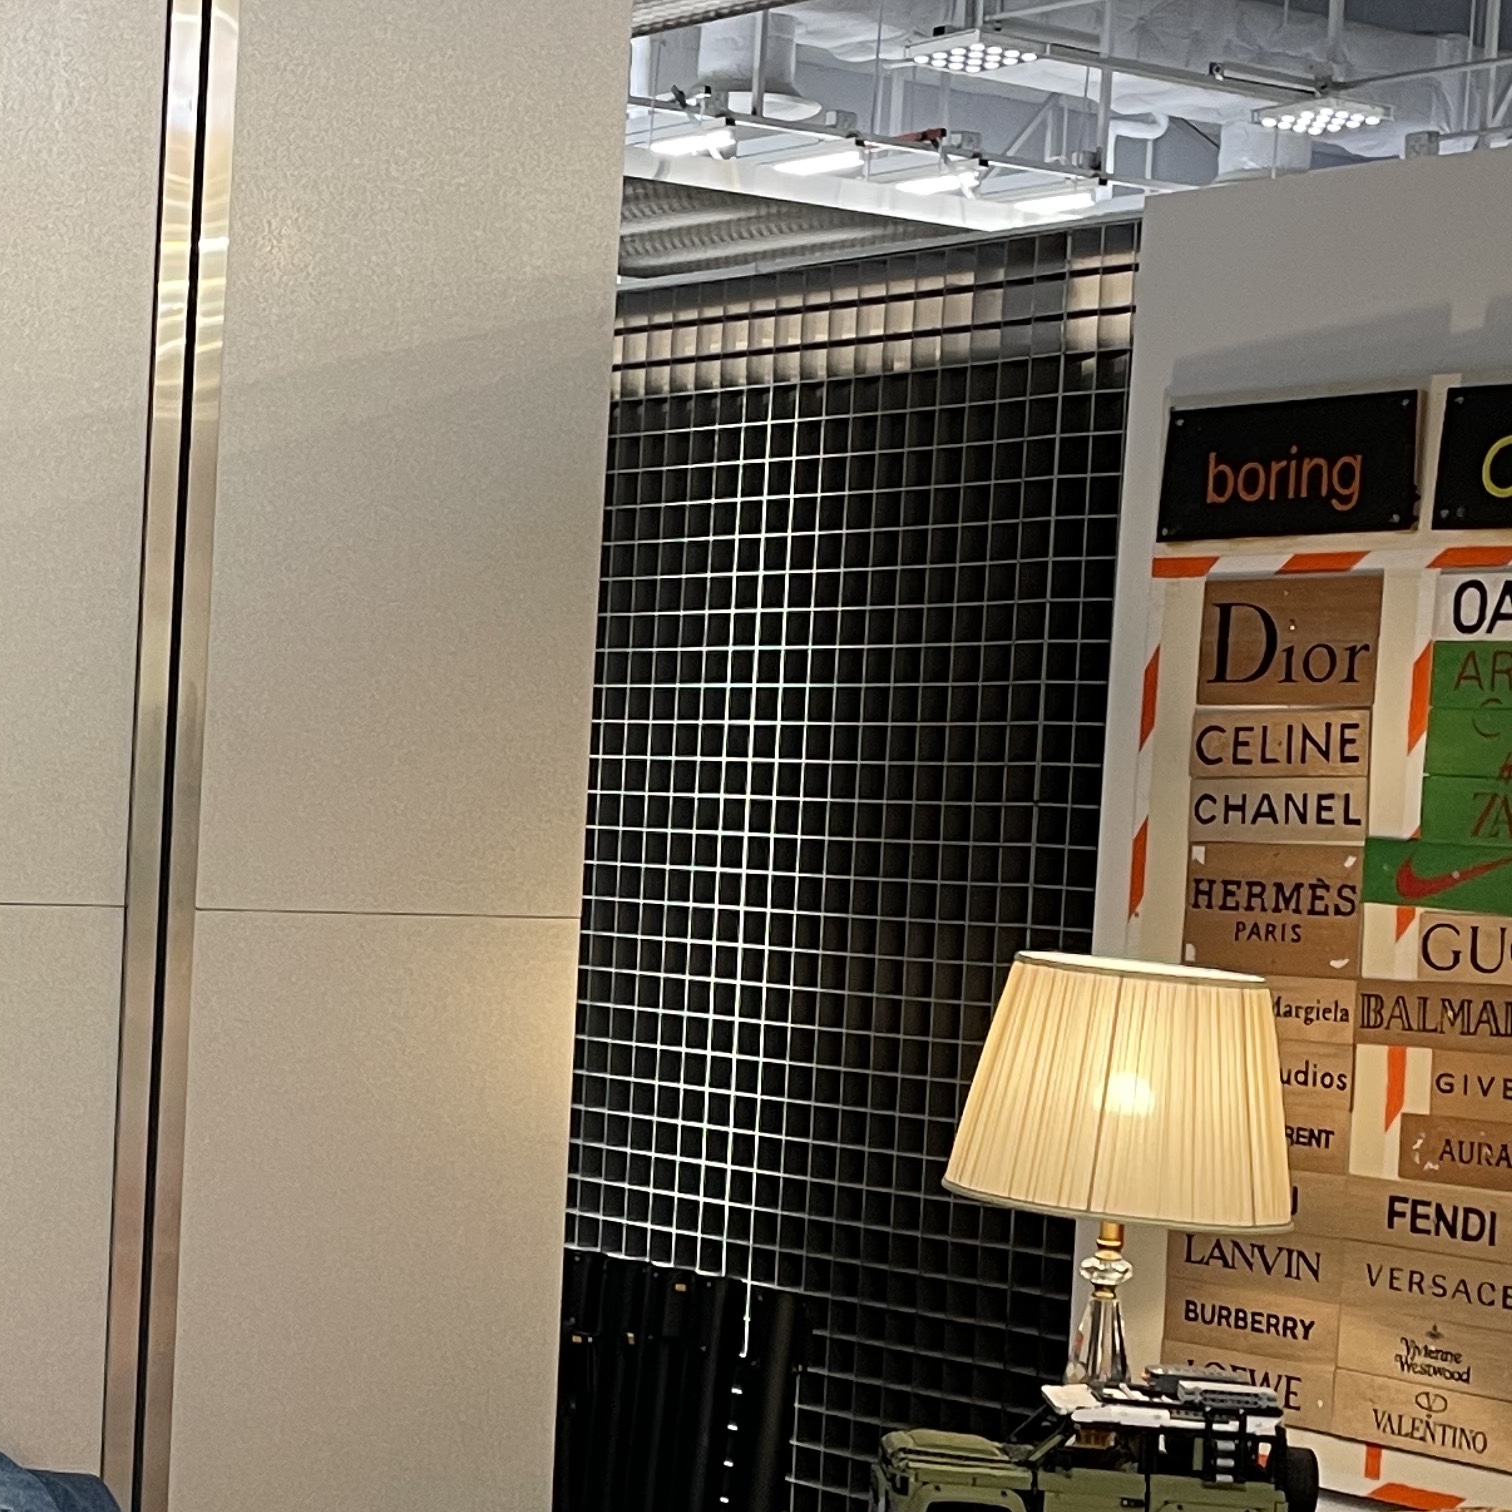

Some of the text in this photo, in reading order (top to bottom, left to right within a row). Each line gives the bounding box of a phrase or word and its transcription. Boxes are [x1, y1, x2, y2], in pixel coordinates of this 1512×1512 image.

[1206, 445, 1363, 511] boring
[1206, 602, 1370, 684] Dior
[1195, 721, 1360, 765] CELINE
[1194, 792, 1362, 826] CHANEL
[1191, 877, 1358, 917] HERMÈS
[1234, 920, 1302, 943] PARIS
[1421, 922, 1512, 974] GU
[1387, 1195, 1497, 1247] FENDI
[1184, 1234, 1321, 1283] LANVIN
[1366, 1263, 1512, 1311] VERSACE
[1184, 1299, 1316, 1341] BURBERRY
[1393, 1353, 1472, 1385] Westwood
[1372, 1407, 1488, 1455] VALENTINO
